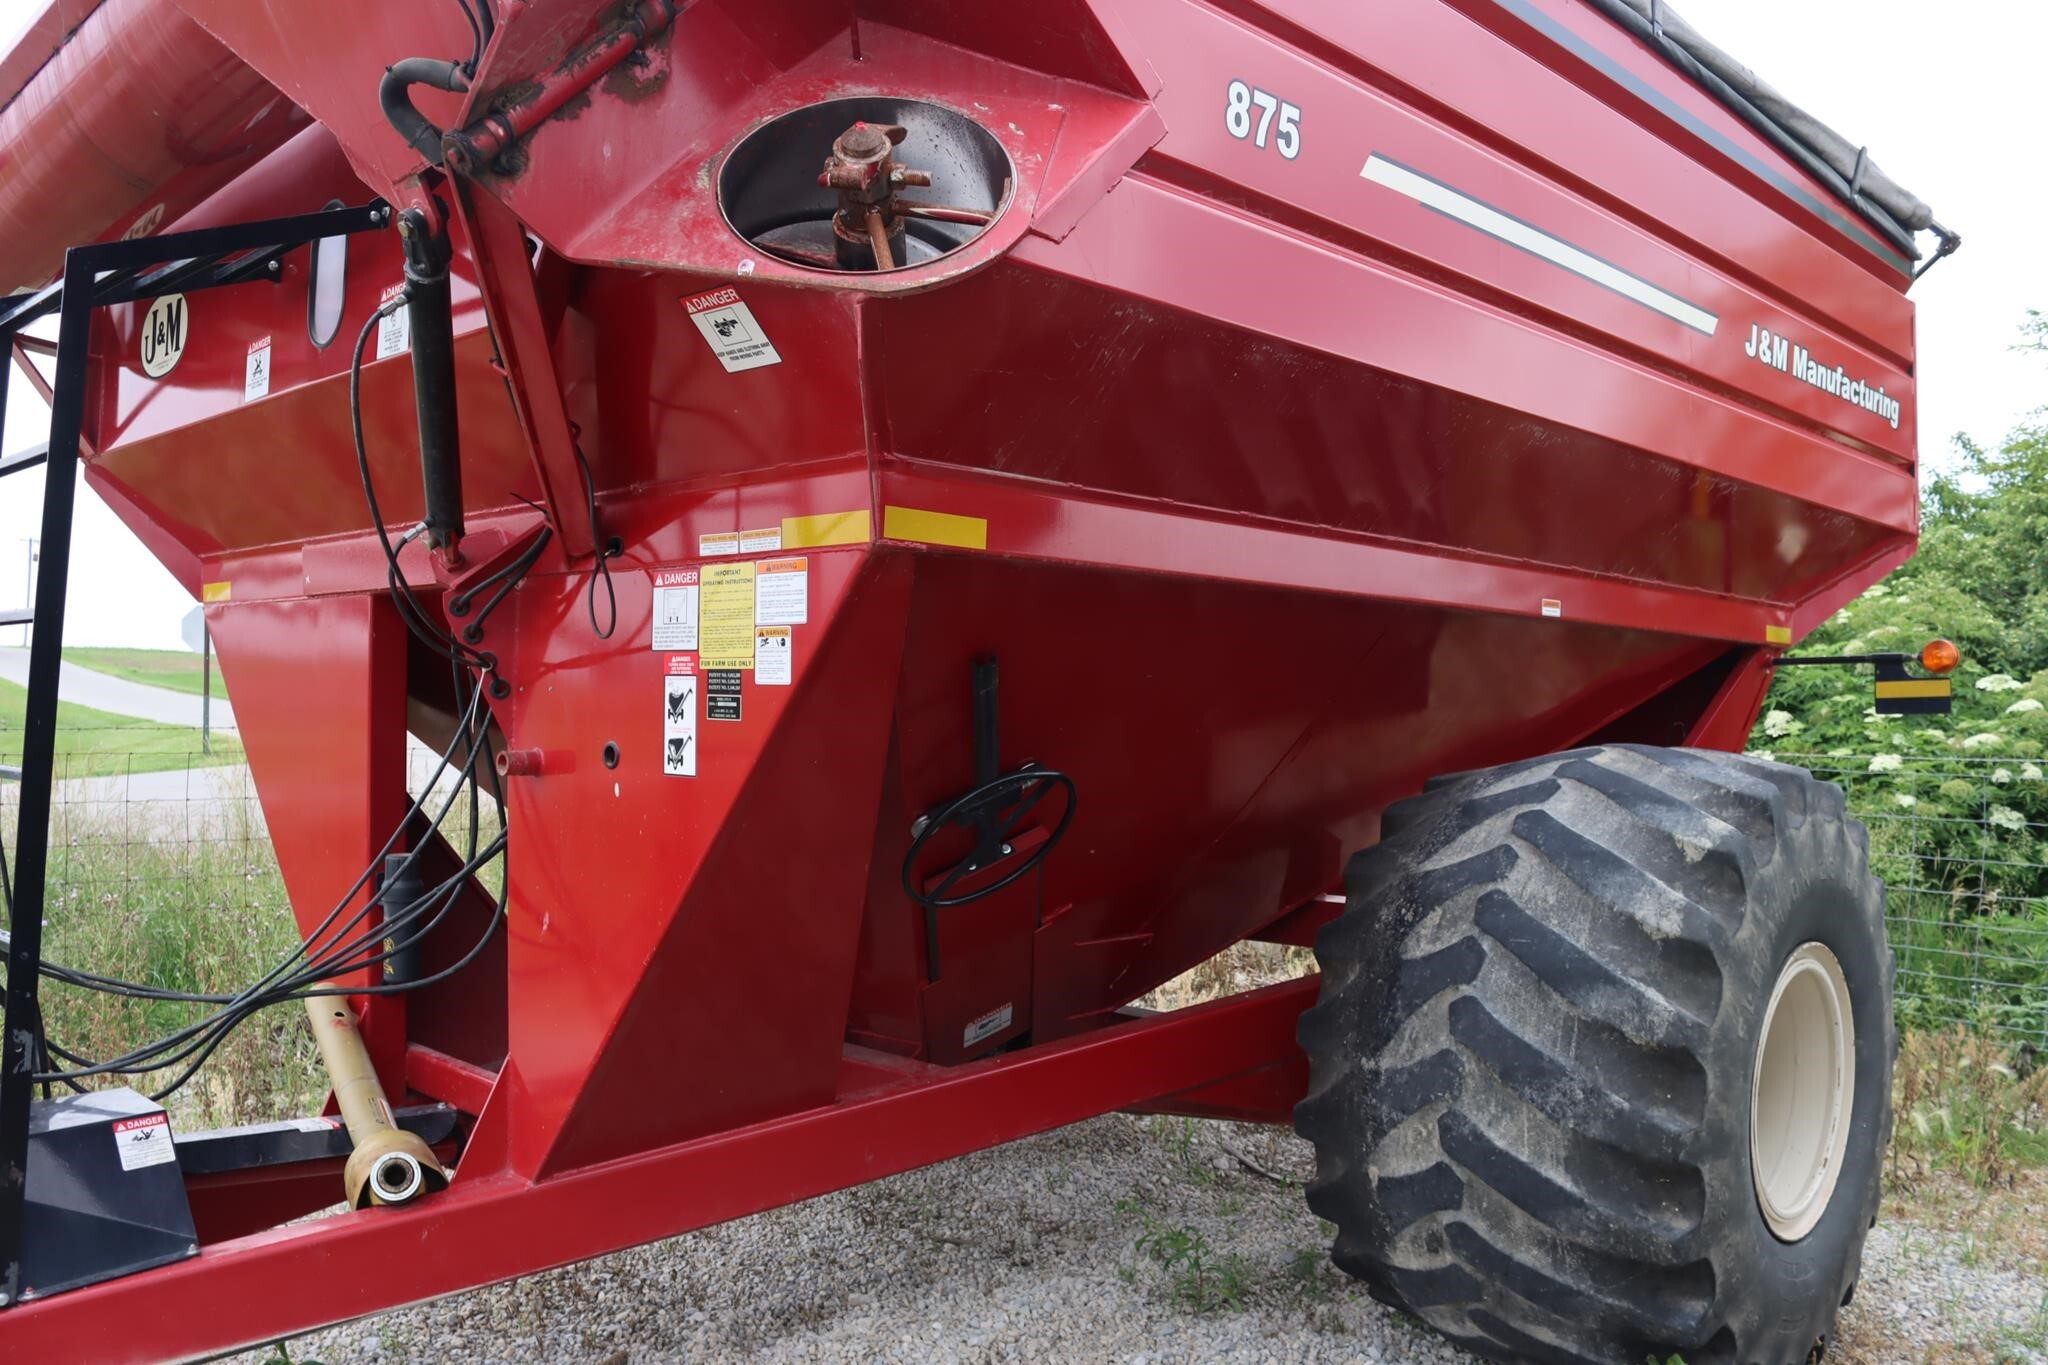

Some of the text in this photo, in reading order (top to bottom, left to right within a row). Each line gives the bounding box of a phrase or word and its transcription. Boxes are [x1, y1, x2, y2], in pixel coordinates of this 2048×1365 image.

[1225, 79, 1301, 160] 875
[387, 282, 406, 297] DANGE
[692, 289, 740, 310] DANGER
[144, 297, 182, 364] J&M
[251, 336, 271, 352] DANGER
[1745, 322, 1900, 430] J&M Manufacturing
[771, 562, 797, 571] WARNING
[664, 572, 698, 585] DANGER
[974, 1001, 1012, 1024] DANGER
[127, 1116, 164, 1129] DANGER
